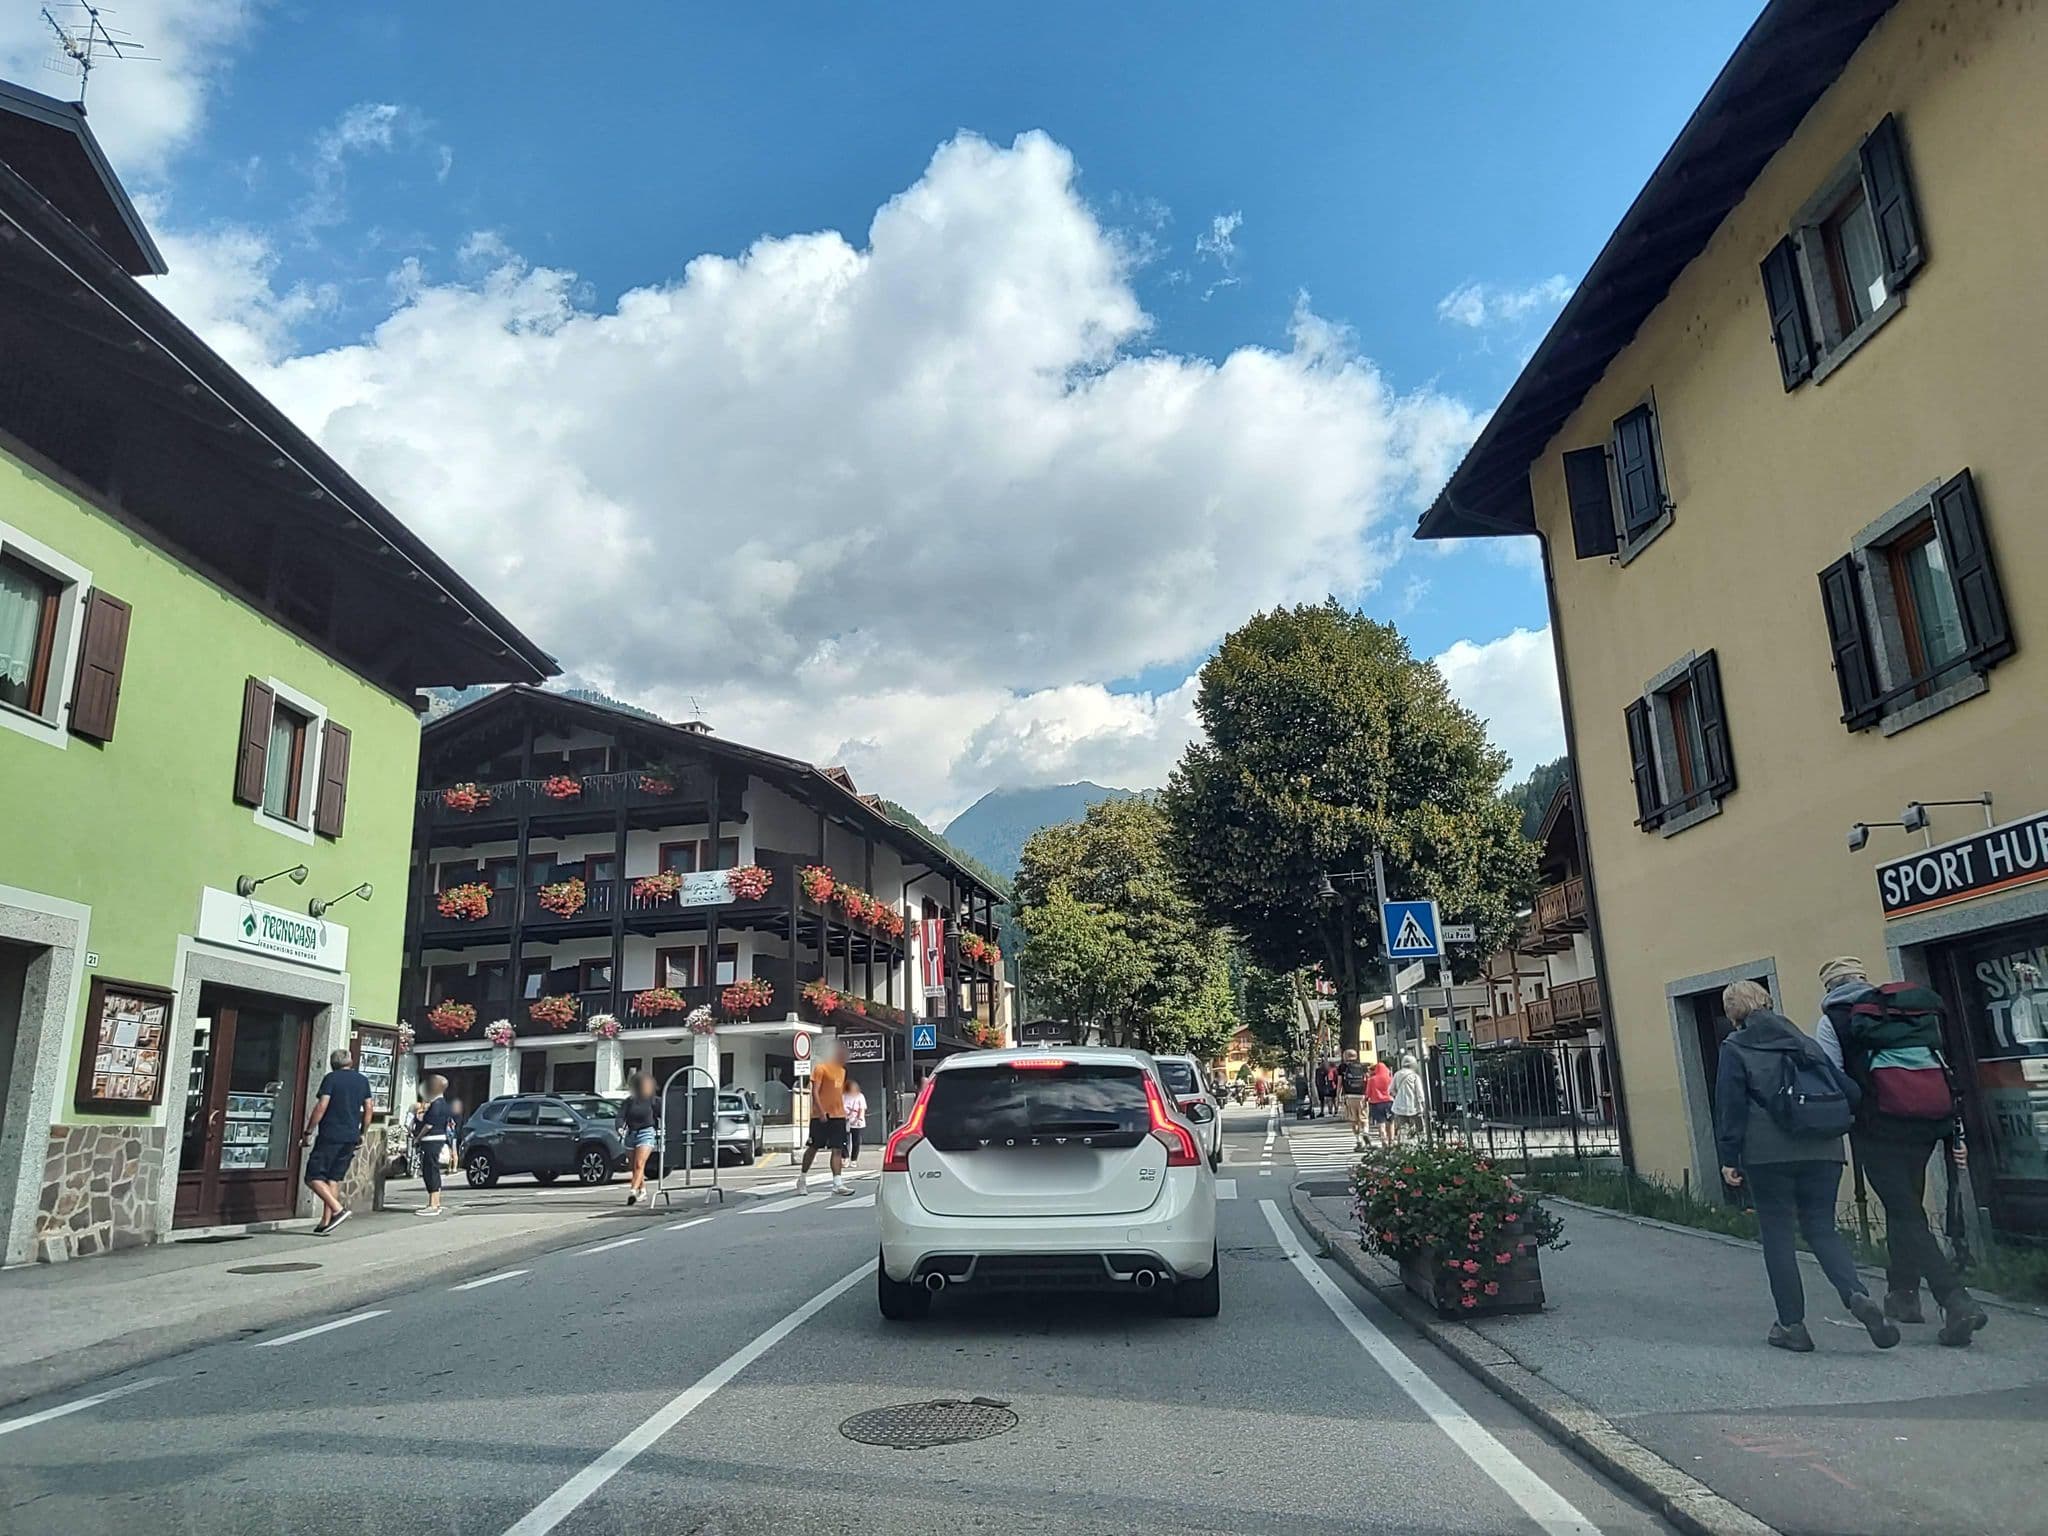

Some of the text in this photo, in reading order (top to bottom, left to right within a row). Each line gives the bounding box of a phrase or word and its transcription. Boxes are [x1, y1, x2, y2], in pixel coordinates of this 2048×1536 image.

[1883, 845, 1974, 905] SPORT
[262, 914, 317, 950] TECNOCASA
[260, 942, 317, 960] FRANCHISING NETWORK
[88, 955, 97, 964] 21
[979, 1137, 1092, 1147] VOLVO
[918, 1171, 942, 1179] V60
